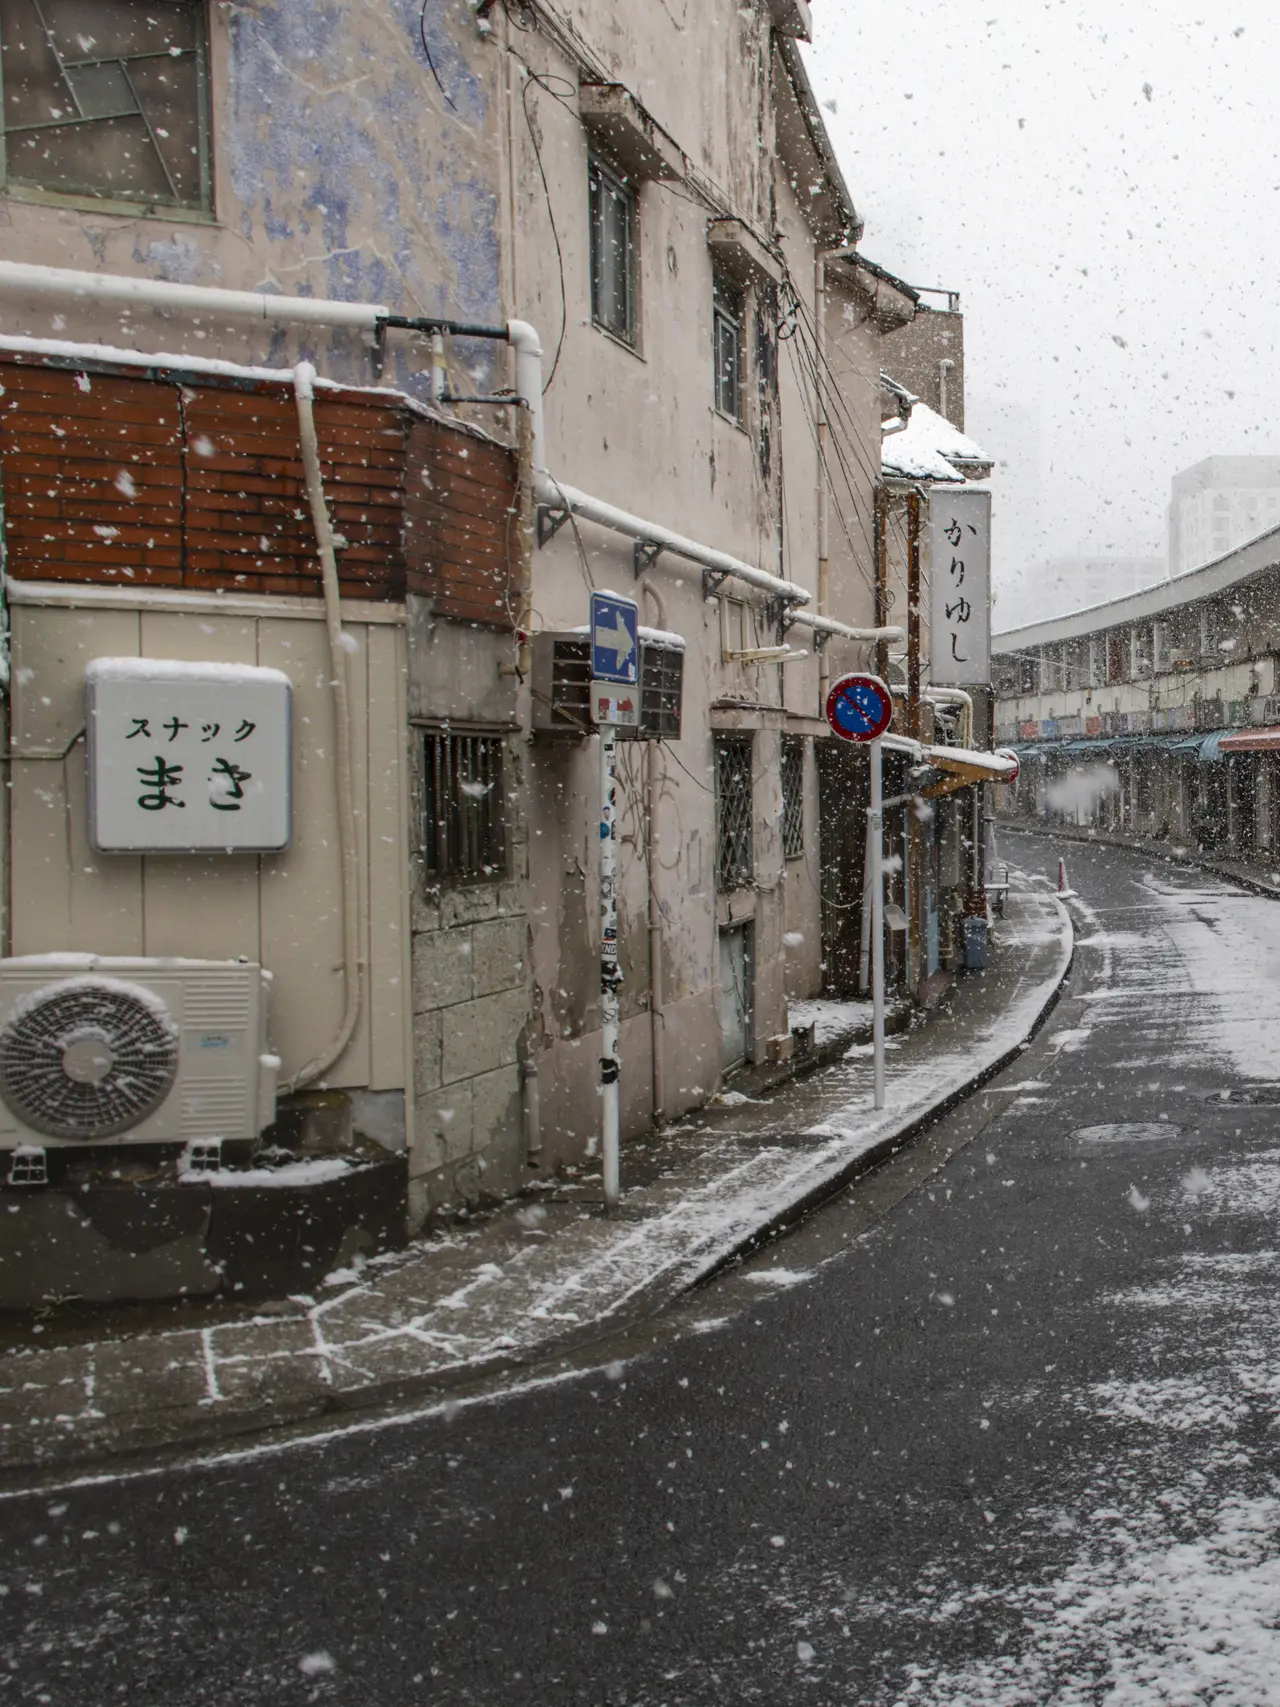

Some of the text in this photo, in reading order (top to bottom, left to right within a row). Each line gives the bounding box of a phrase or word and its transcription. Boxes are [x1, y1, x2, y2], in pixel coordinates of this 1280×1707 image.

[943, 518, 977, 663] かりゆし
[125, 716, 257, 743] スナック
